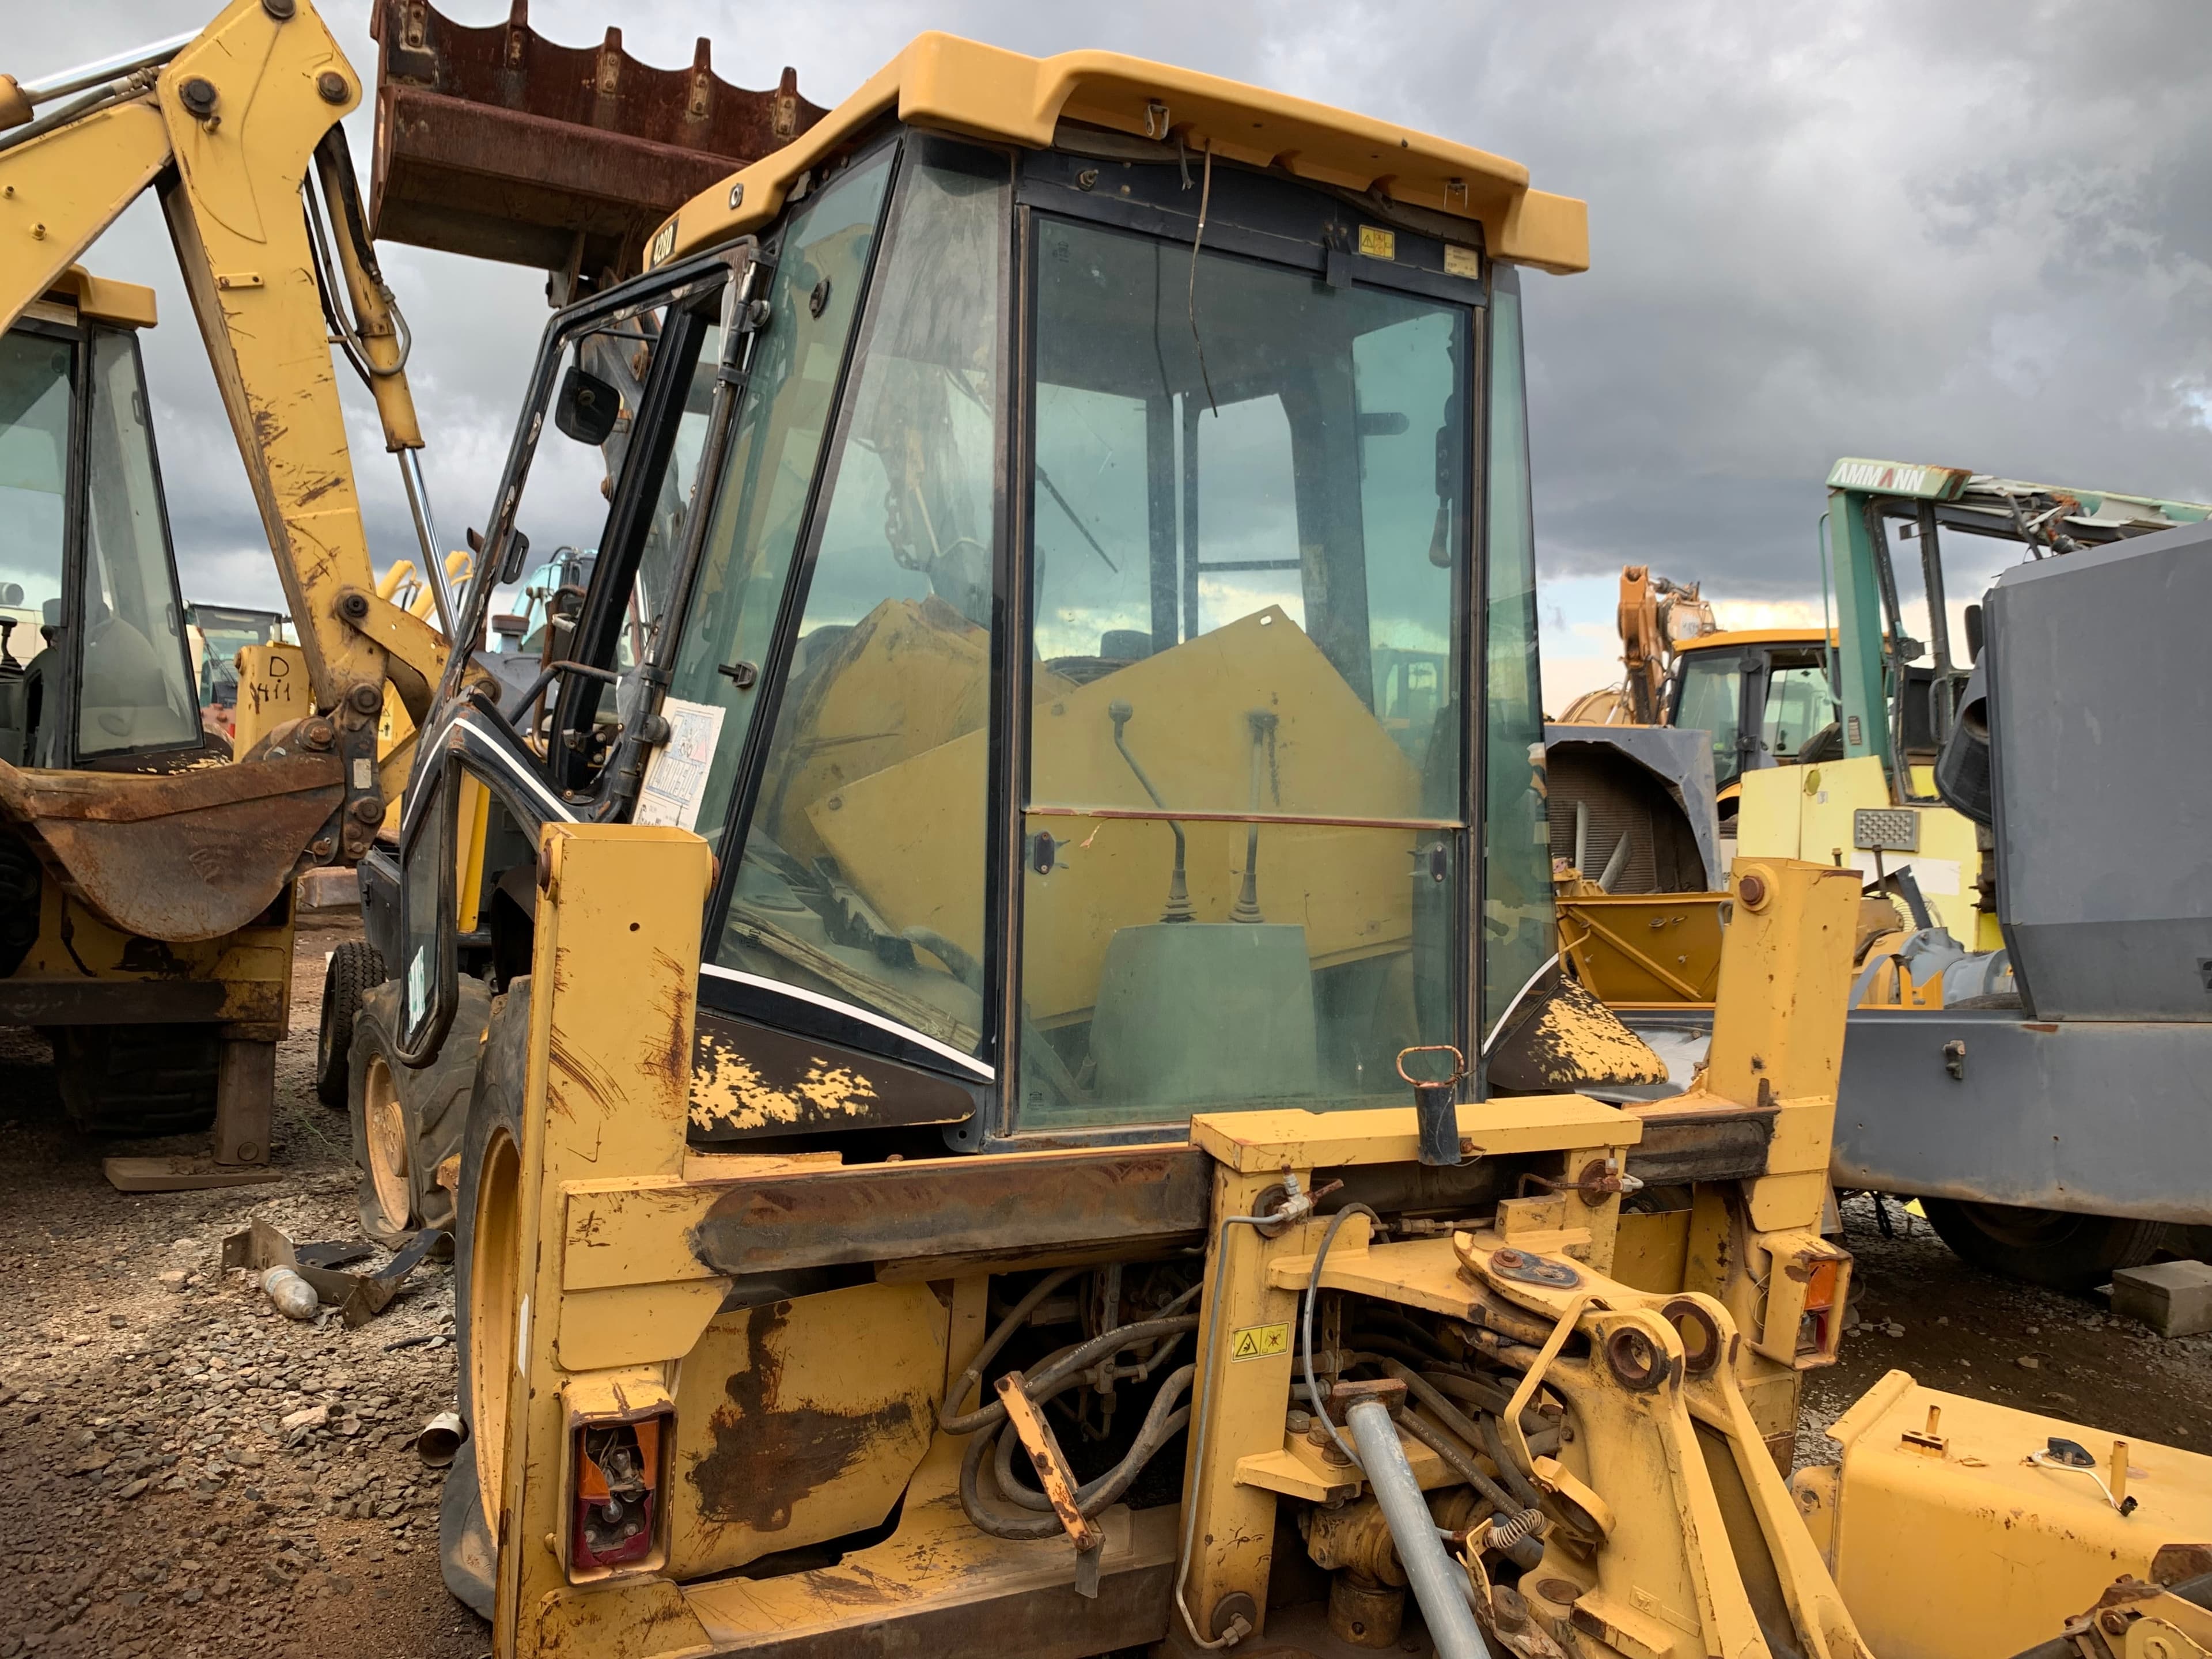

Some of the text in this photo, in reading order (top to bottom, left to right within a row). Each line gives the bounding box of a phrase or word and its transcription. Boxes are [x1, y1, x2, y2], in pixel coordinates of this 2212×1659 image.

[653, 224, 673, 266] 428D
[1831, 463, 1926, 491] AMMANN
[270, 656, 289, 677] D
